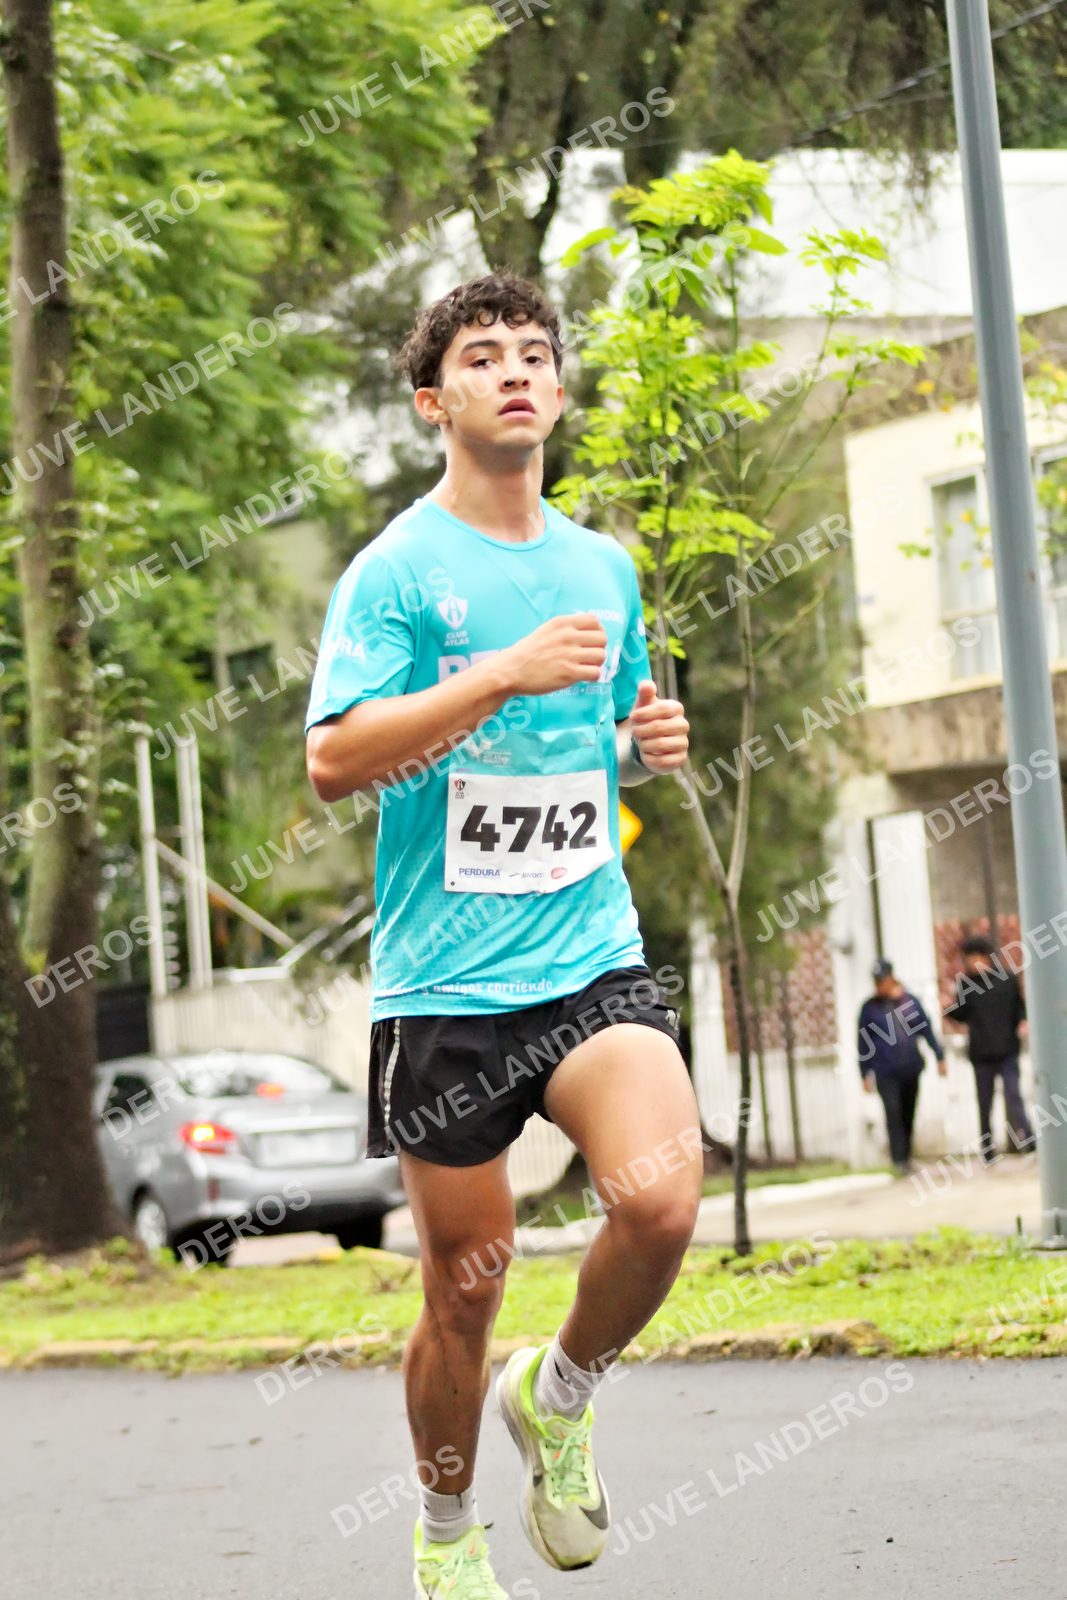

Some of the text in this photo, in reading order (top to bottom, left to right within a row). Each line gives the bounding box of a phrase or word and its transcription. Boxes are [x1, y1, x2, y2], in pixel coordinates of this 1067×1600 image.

[446, 630, 468, 640] CLUB
[444, 637, 470, 647] ATLAS
[460, 801, 597, 852] 4742
[458, 867, 501, 877] PERDURA
[433, 982, 482, 996] amigos
[487, 978, 553, 993] corriendo
